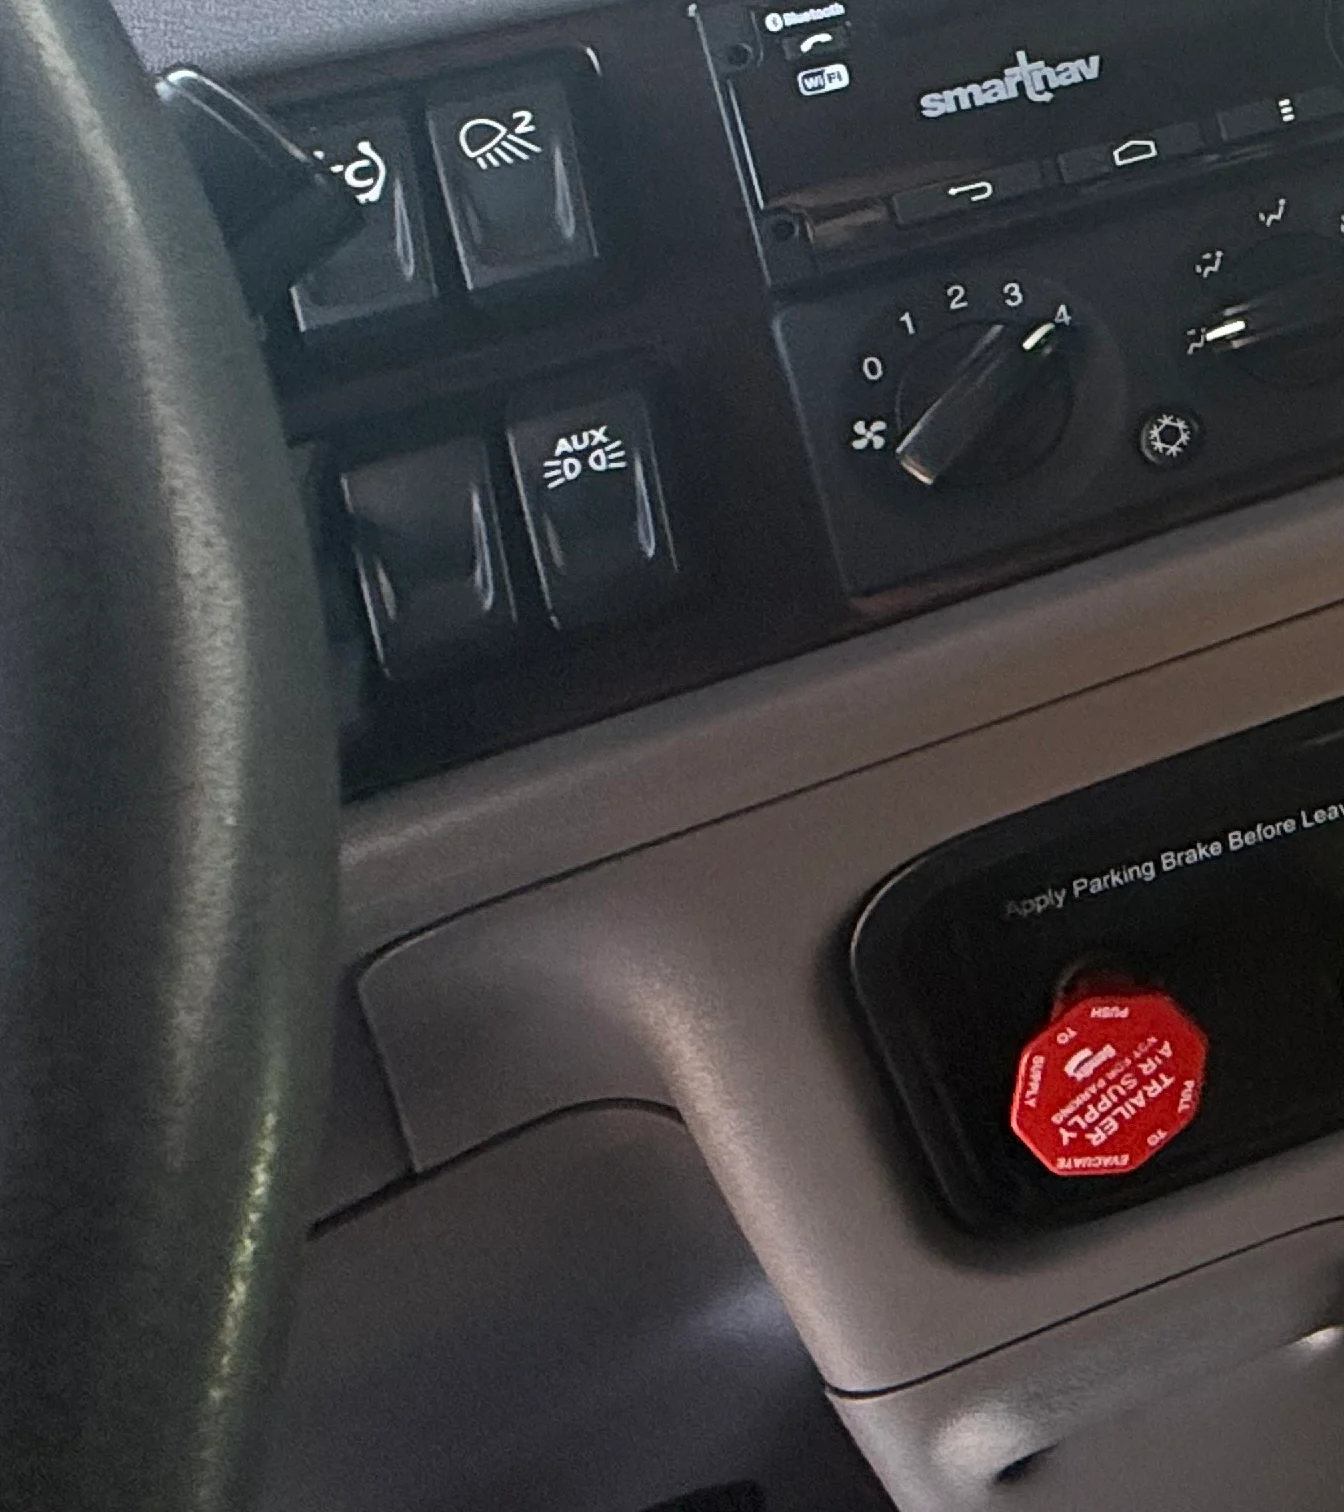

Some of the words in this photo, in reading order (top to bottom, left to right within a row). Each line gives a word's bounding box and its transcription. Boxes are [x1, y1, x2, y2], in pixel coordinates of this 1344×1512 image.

[919, 50, 1101, 119] smartnav
[512, 110, 537, 134] 2
[947, 284, 969, 310] 2
[1003, 282, 1024, 308] 3
[900, 312, 916, 336] 1
[1053, 304, 1072, 327] 4
[861, 356, 884, 382] 0
[555, 425, 611, 457] AUX
[1004, 886, 1066, 919] Apply
[1072, 858, 1157, 899] Parking
[1160, 837, 1224, 873] Brake
[1227, 816, 1297, 852] Before
[1057, 1027, 1078, 1044] TO
[1137, 1040, 1173, 1076] AIR
[1050, 1077, 1107, 1125] PARKING
[1058, 1073, 1138, 1146] SUPPLY
[1085, 1072, 1176, 1147] TRAILER
[1177, 1080, 1195, 1114] PULL
[1147, 1128, 1169, 1146] TO
[1056, 1153, 1130, 1170] EVACUATE
